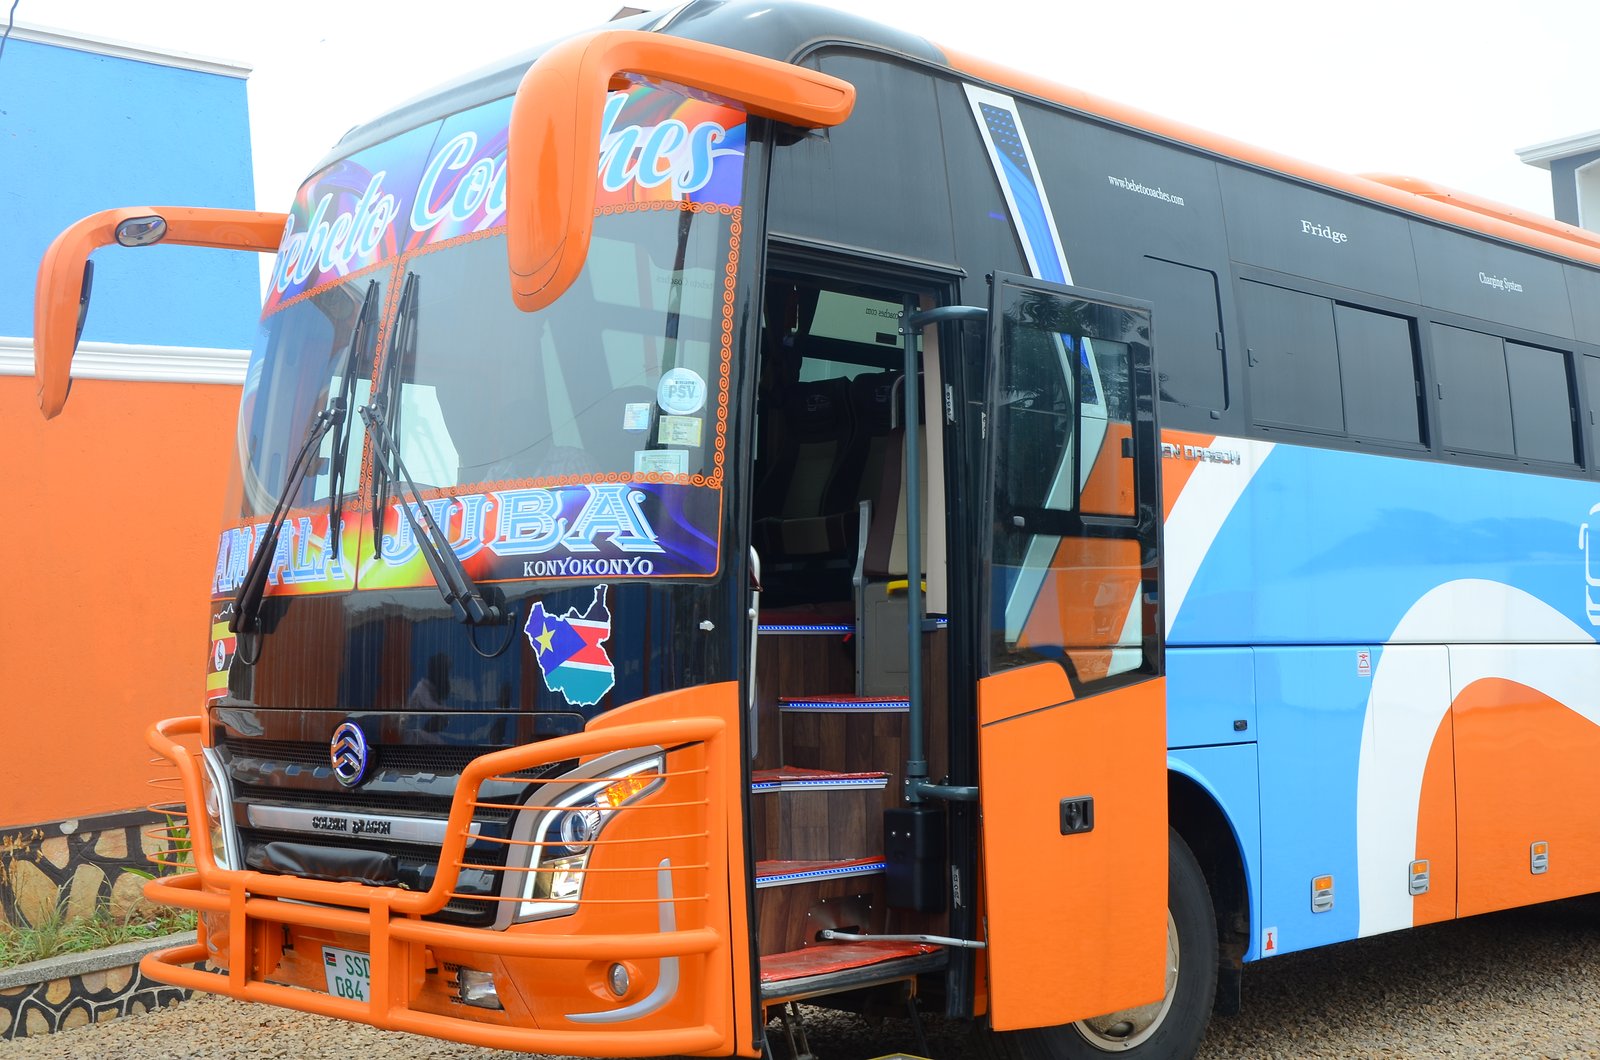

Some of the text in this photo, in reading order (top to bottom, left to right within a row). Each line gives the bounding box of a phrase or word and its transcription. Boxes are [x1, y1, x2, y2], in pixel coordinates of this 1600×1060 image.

[410, 92, 744, 232] Cohes
[1107, 175, 1185, 206] www.bebetocoaches.com
[1300, 219, 1348, 244] Fridge
[1479, 271, 1523, 292] Charging System
[668, 385, 696, 399] PSV
[379, 483, 666, 567] JUBA
[522, 556, 654, 577] KONYOKONYO
[312, 816, 391, 835] GOLDEN DRAGON
[335, 975, 370, 1002] 084
